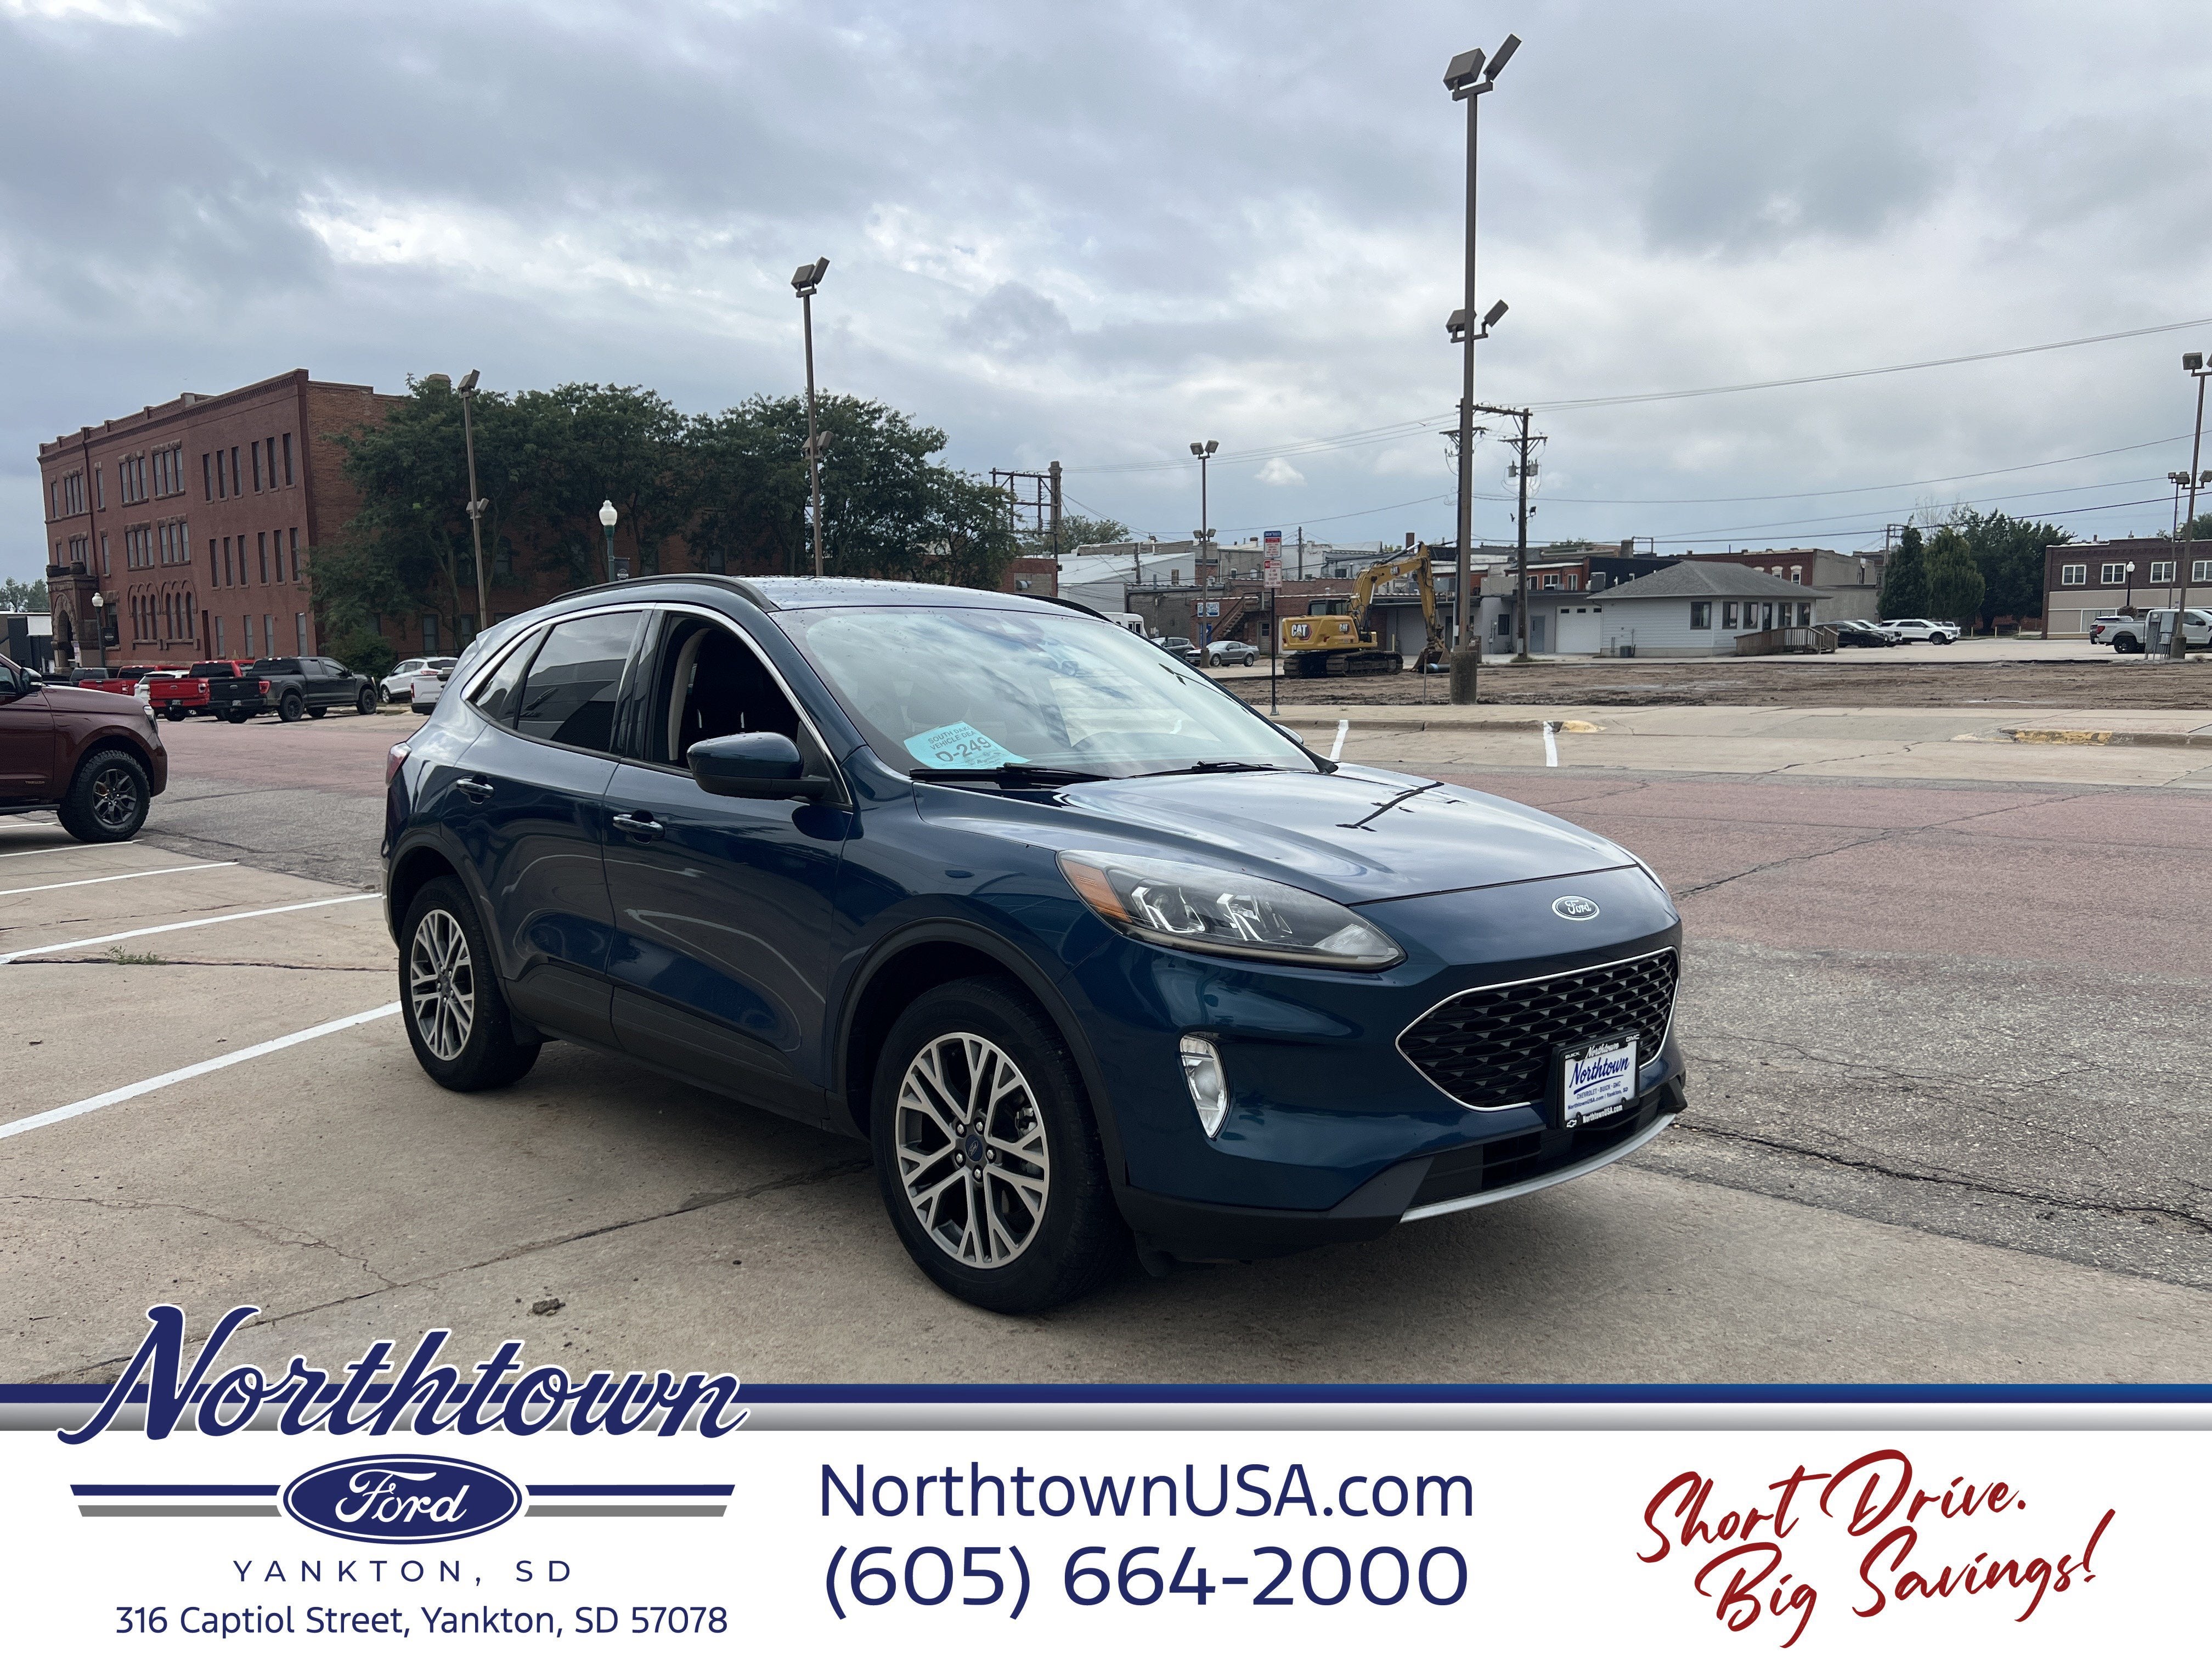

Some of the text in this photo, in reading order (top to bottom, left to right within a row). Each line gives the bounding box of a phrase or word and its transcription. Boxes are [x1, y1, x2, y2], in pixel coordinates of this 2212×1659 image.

[1291, 624, 1307, 637] CAT
[1339, 624, 1348, 632] CAT
[928, 731, 953, 744] SOUTH
[930, 735, 961, 750] VEHICLE
[935, 737, 991, 762] D-249
[1565, 899, 1592, 915] Ford
[1626, 1034, 1640, 1042] GMC
[1565, 1051, 1580, 1059] BUICK
[1585, 1043, 1619, 1059] Northtown
[1568, 1057, 1629, 1088] Northtown
[1576, 1088, 1597, 1099] CHEVROLET
[1600, 1084, 1610, 1092] BUICK
[1582, 1104, 1623, 1124] NorthtownUSA.com
